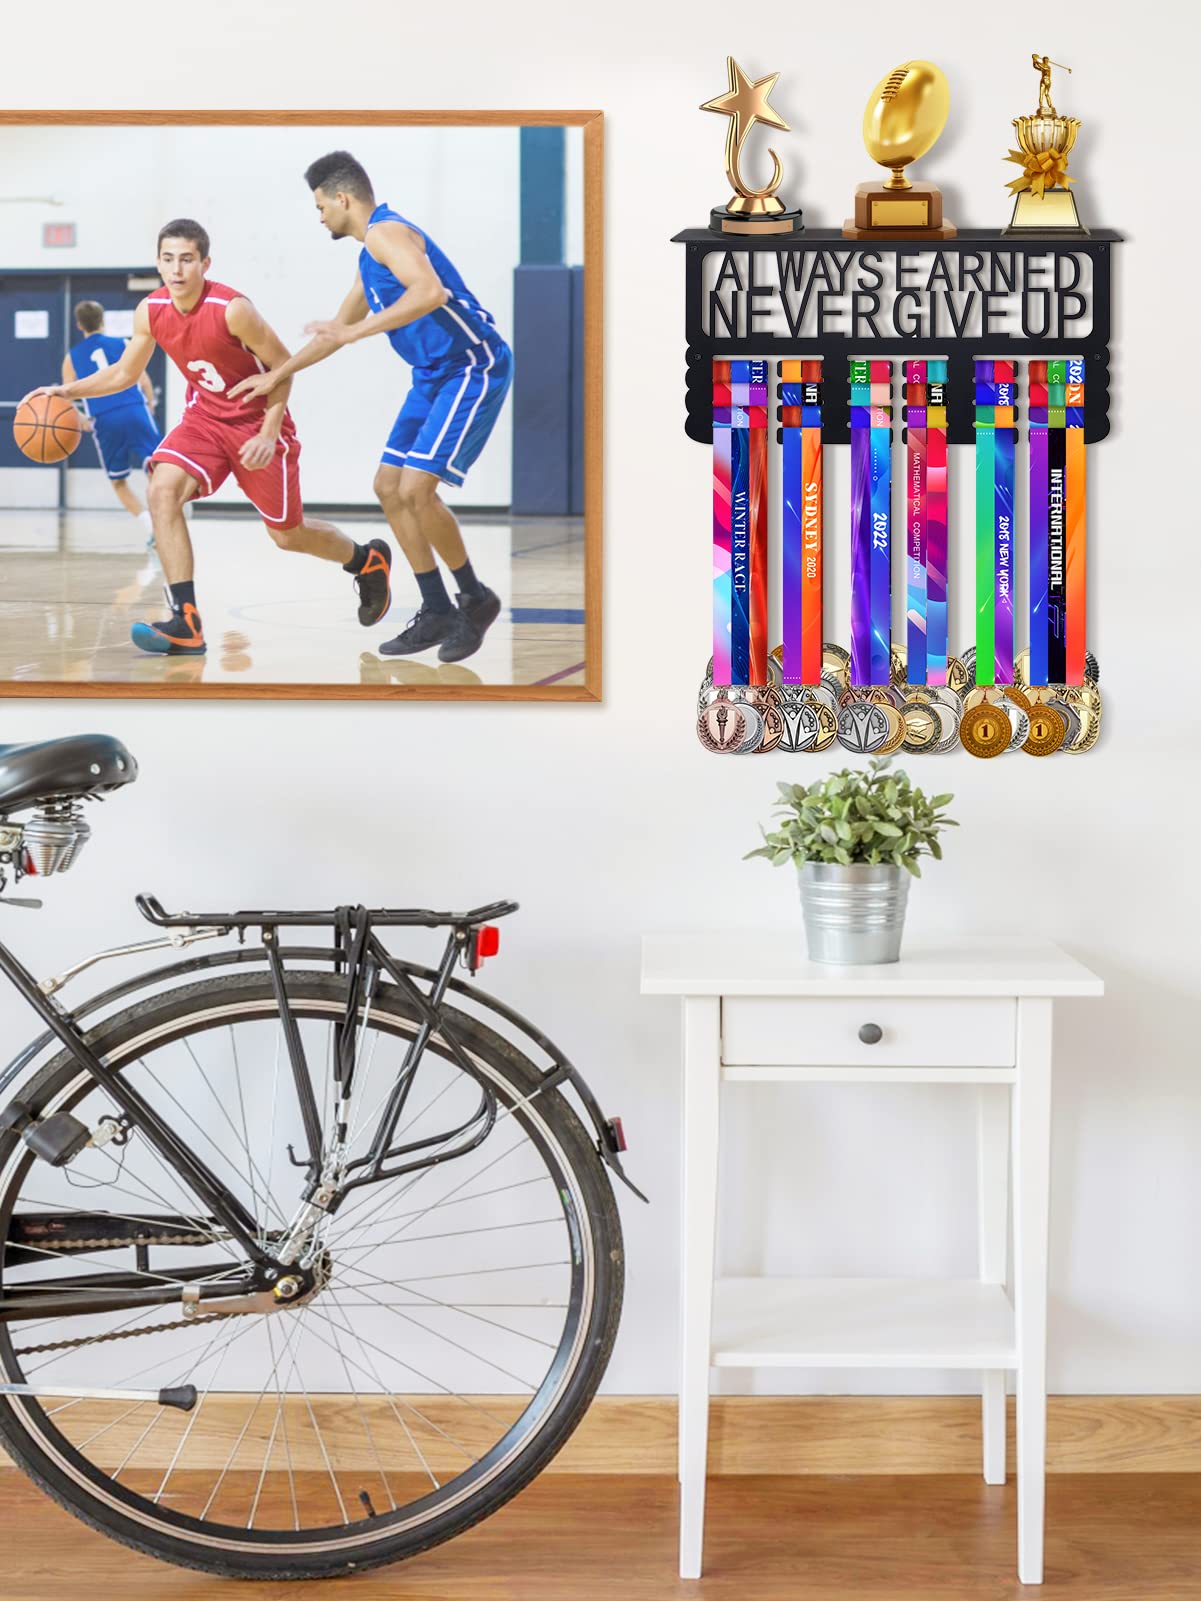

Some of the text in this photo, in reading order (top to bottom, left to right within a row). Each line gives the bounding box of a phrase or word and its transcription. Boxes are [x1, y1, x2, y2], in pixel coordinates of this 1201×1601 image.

[715, 250, 1081, 292] ALWAYS EARNED
[710, 291, 1086, 338] NEVER GIVE UP
[90, 347, 109, 373] 1
[187, 360, 226, 392] 3
[805, 482, 817, 578] SYDNEY 2020
[873, 512, 888, 549] 2022
[913, 452, 921, 579] MATHEMATICAL COMPETITION
[1051, 469, 1062, 591] INTERNATIONAL
[734, 491, 746, 592] WINTER RACE
[996, 515, 1010, 598] 2018 NEW YORK
[981, 724, 989, 738] 1
[1036, 724, 1043, 737] 1
